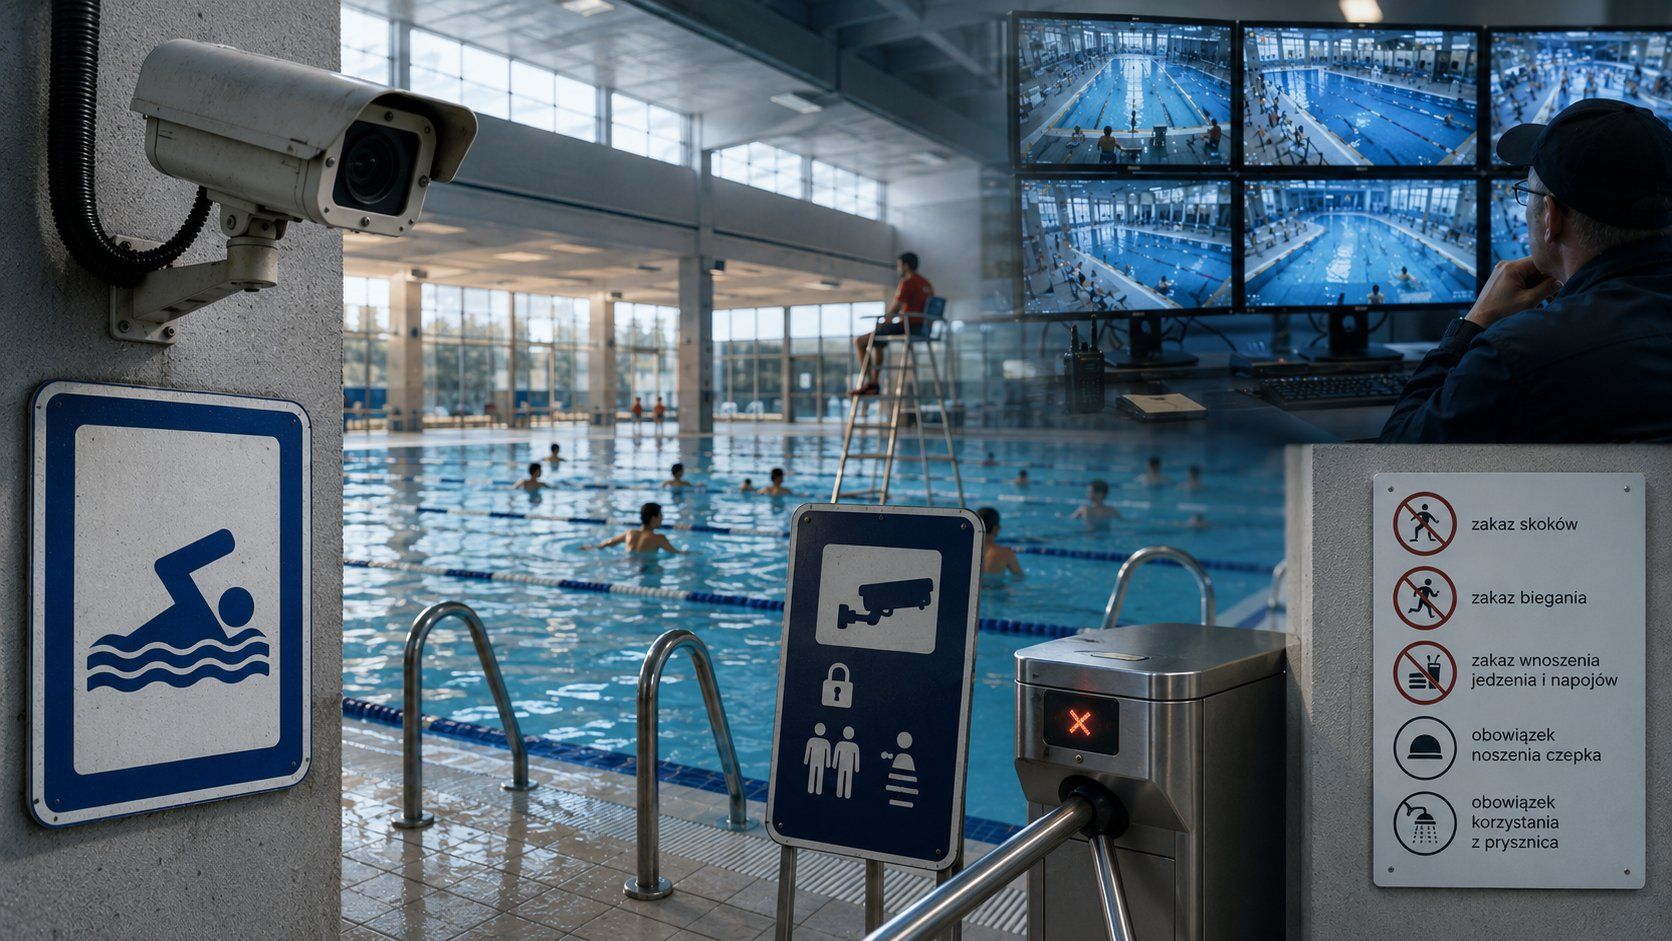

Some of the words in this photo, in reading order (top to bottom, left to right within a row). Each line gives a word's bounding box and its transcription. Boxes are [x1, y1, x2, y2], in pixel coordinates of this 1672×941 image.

[1472, 517, 1515, 531] zakaz
[1520, 517, 1578, 531] skoków
[1472, 591, 1515, 604] zakaz
[1521, 590, 1587, 608] biegania
[1472, 653, 1515, 667] zakaz
[1519, 653, 1600, 667] wnoszenia
[1471, 672, 1536, 690] jedzenia
[1541, 672, 1546, 687] i
[1551, 672, 1619, 690] napojów
[1472, 728, 1556, 745] obowiązek
[1472, 748, 1541, 762] noszenia
[1546, 748, 1601, 766] czepka
[1472, 795, 1556, 812] obowiązek
[1472, 814, 1559, 833] korzystania
[1472, 836, 1480, 848] z
[1485, 837, 1559, 852] prysznica
